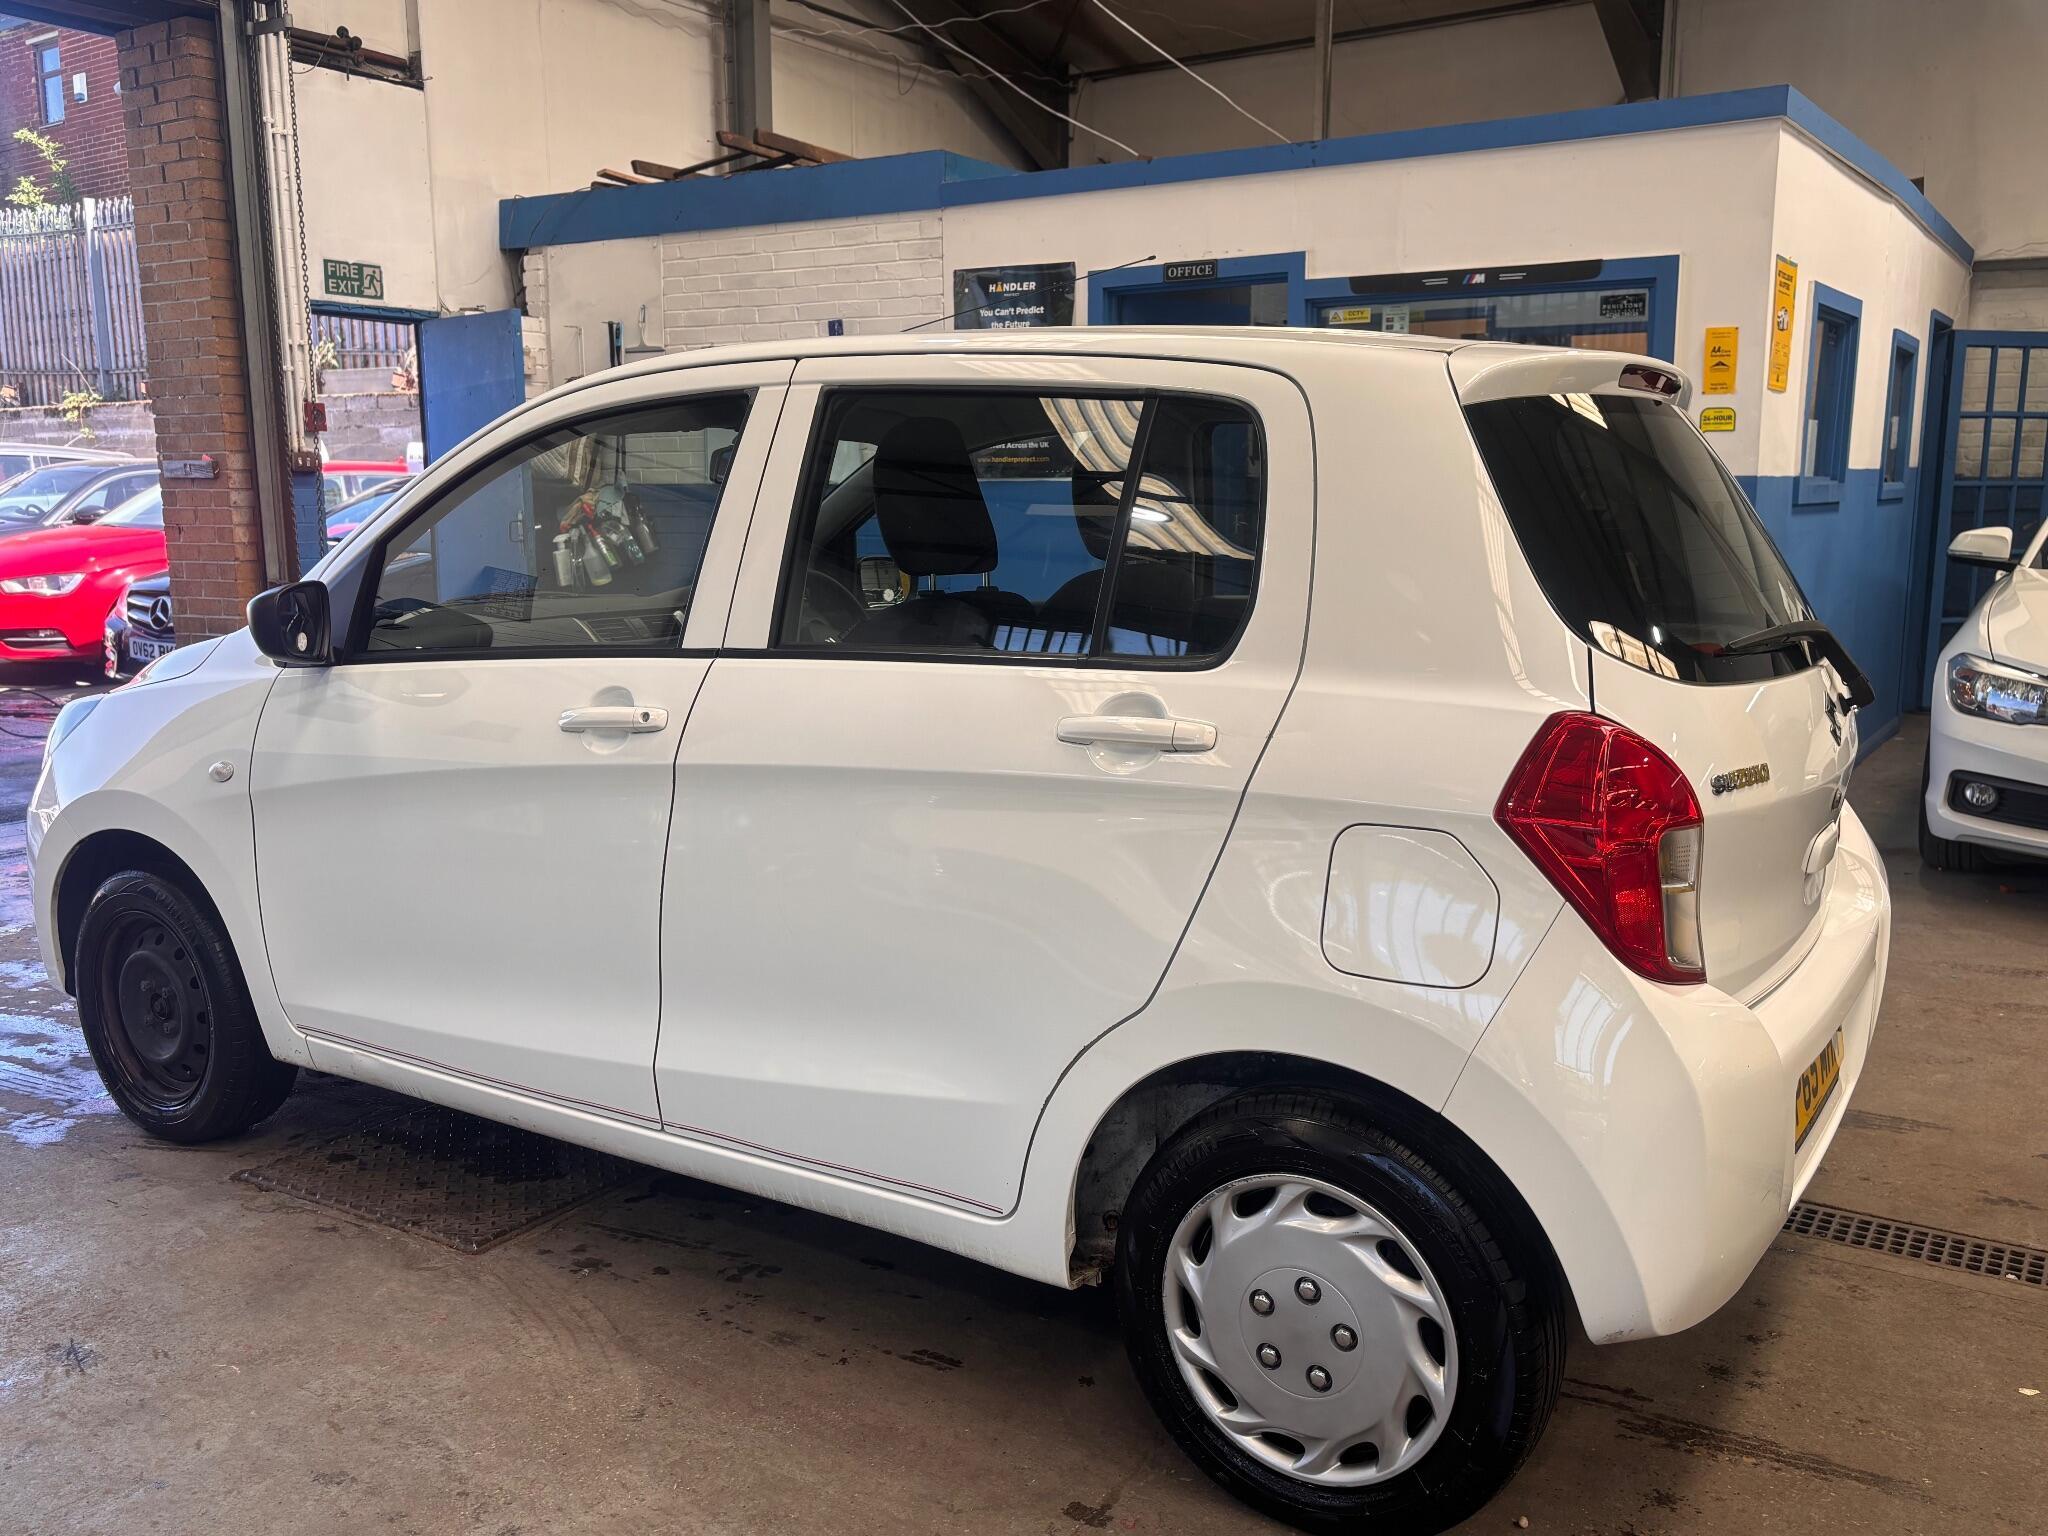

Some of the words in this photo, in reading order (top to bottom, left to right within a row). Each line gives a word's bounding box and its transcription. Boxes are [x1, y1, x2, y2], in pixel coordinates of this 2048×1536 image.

[327, 262, 359, 278] FIRE
[1168, 264, 1213, 278] OFFICE
[328, 278, 360, 294] EXIT
[980, 308, 993, 317] You
[994, 307, 1015, 316] Can't
[1016, 306, 1044, 316] Predict
[991, 321, 1004, 329] the
[1005, 320, 1031, 329] Future
[132, 640, 155, 659] OV62
